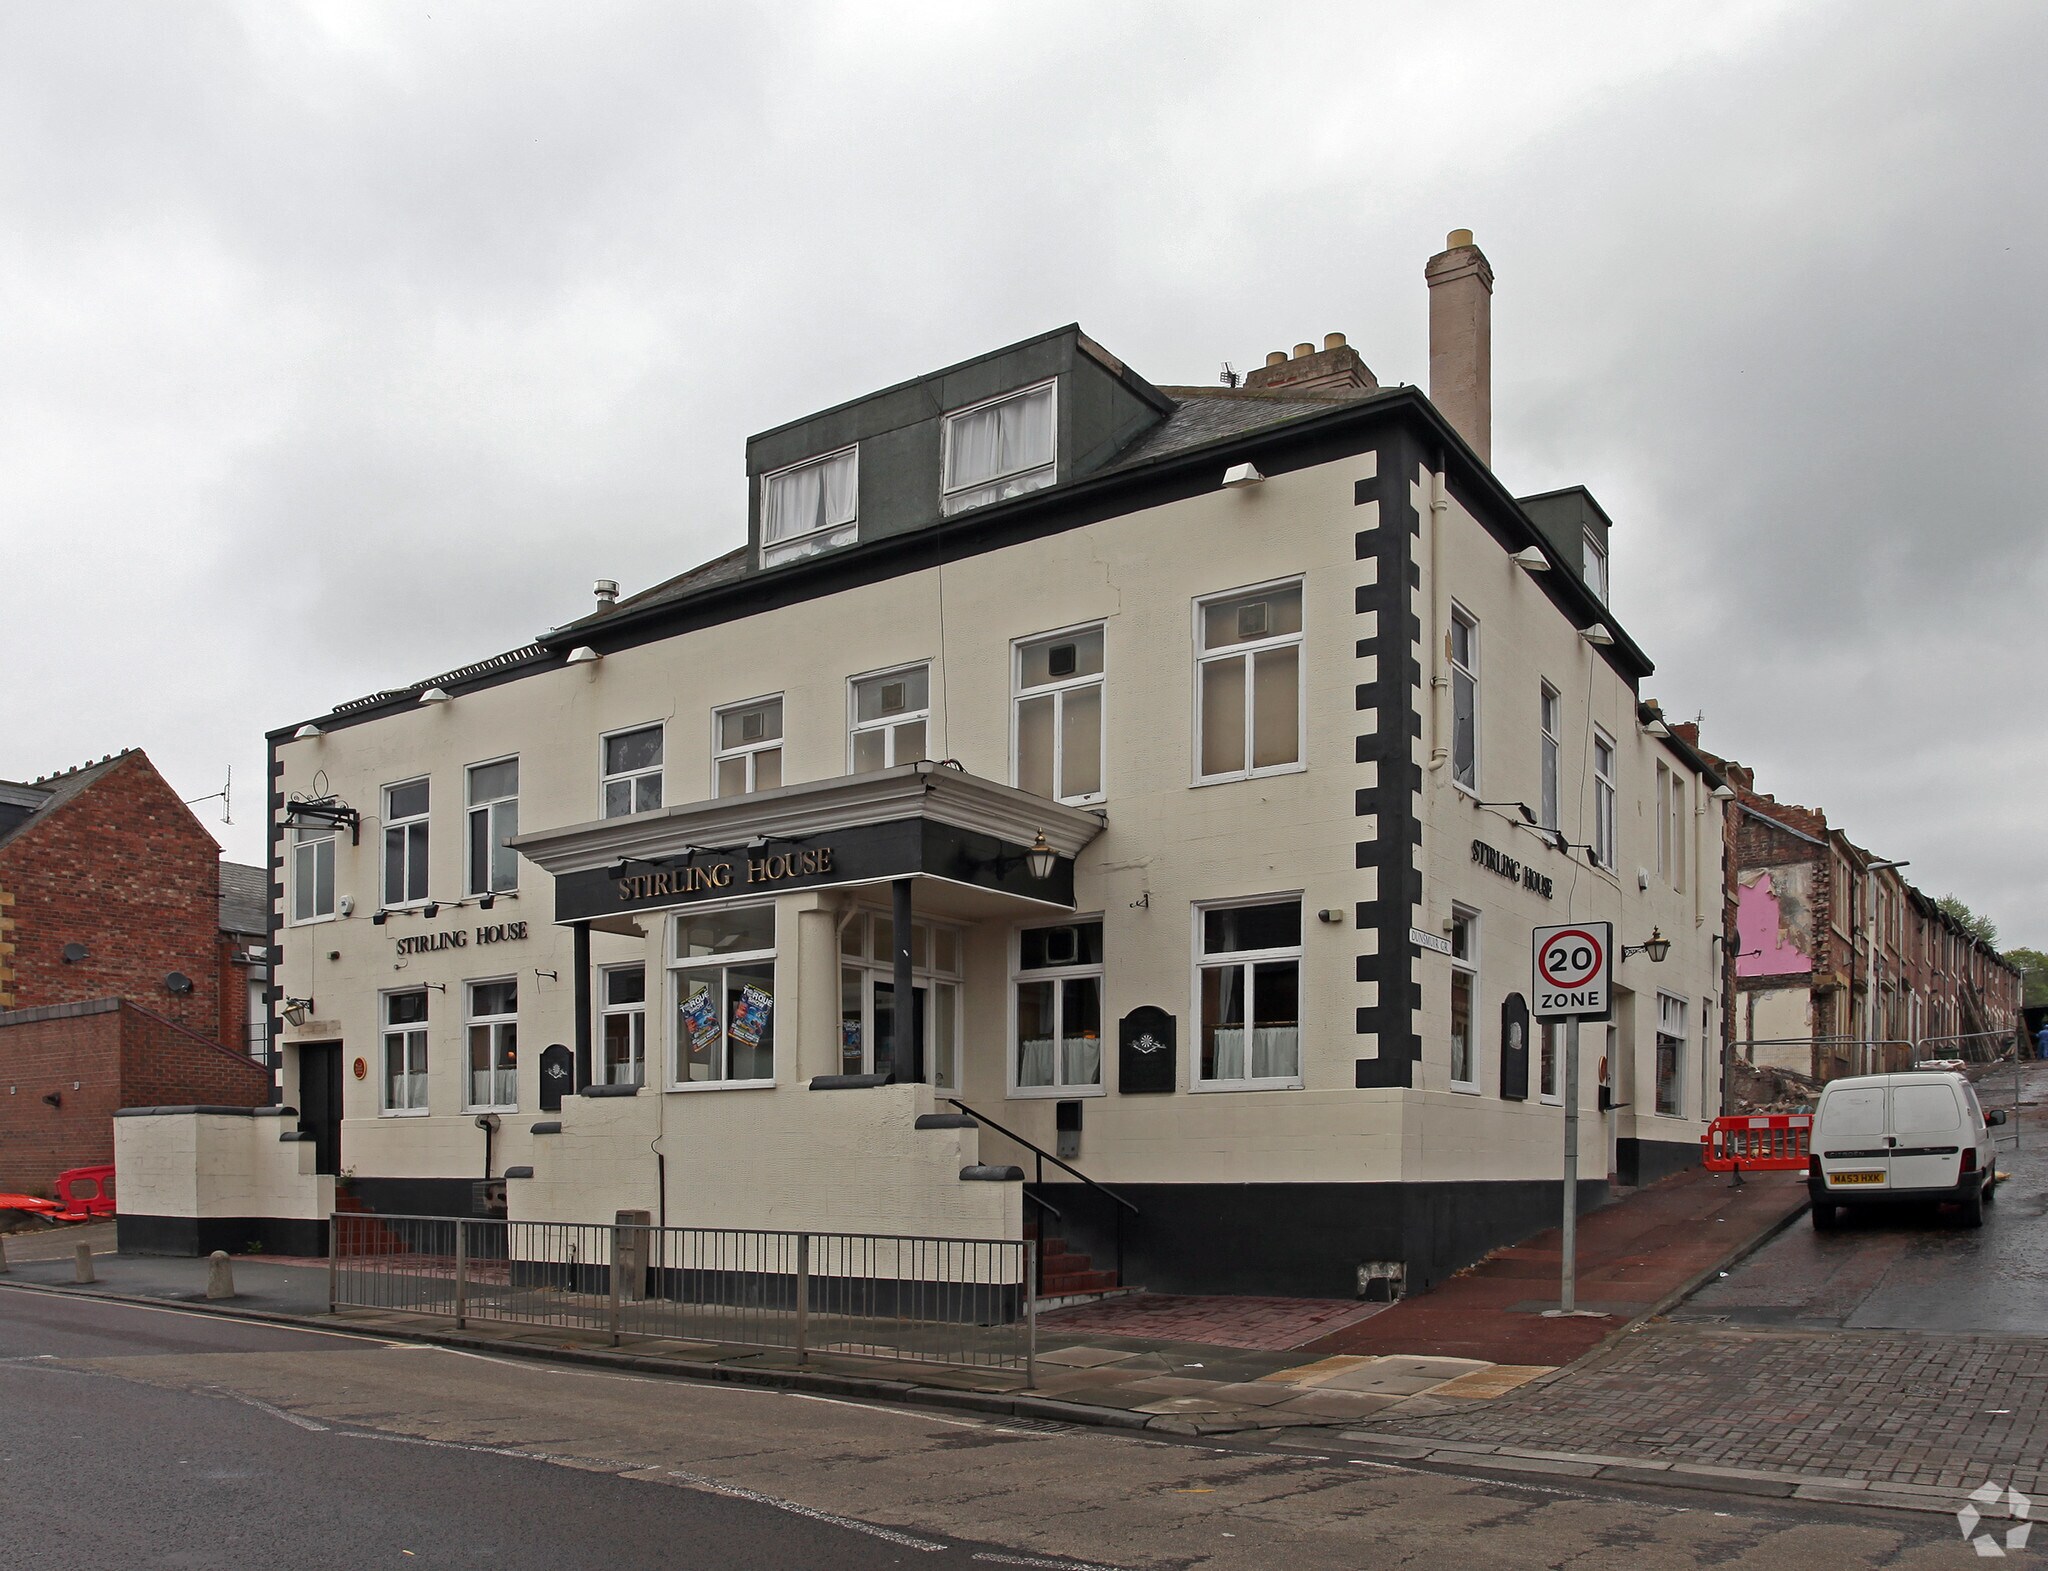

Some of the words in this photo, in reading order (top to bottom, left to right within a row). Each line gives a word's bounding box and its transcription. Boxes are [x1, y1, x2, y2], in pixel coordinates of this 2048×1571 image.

[618, 863, 731, 901] STIRLING
[746, 847, 833, 884] HOUSE
[1471, 839, 1520, 883] STIRLING
[1522, 865, 1553, 900] HOUSE
[397, 930, 467, 955] STIRLING
[476, 921, 528, 945] HOUSE
[1411, 930, 1439, 949] DUNSMUIR
[1548, 946, 1592, 972] 20
[1541, 991, 1599, 1009] ZONE
[1834, 1174, 1859, 1183] MA53
[1861, 1173, 1881, 1182] HXK
